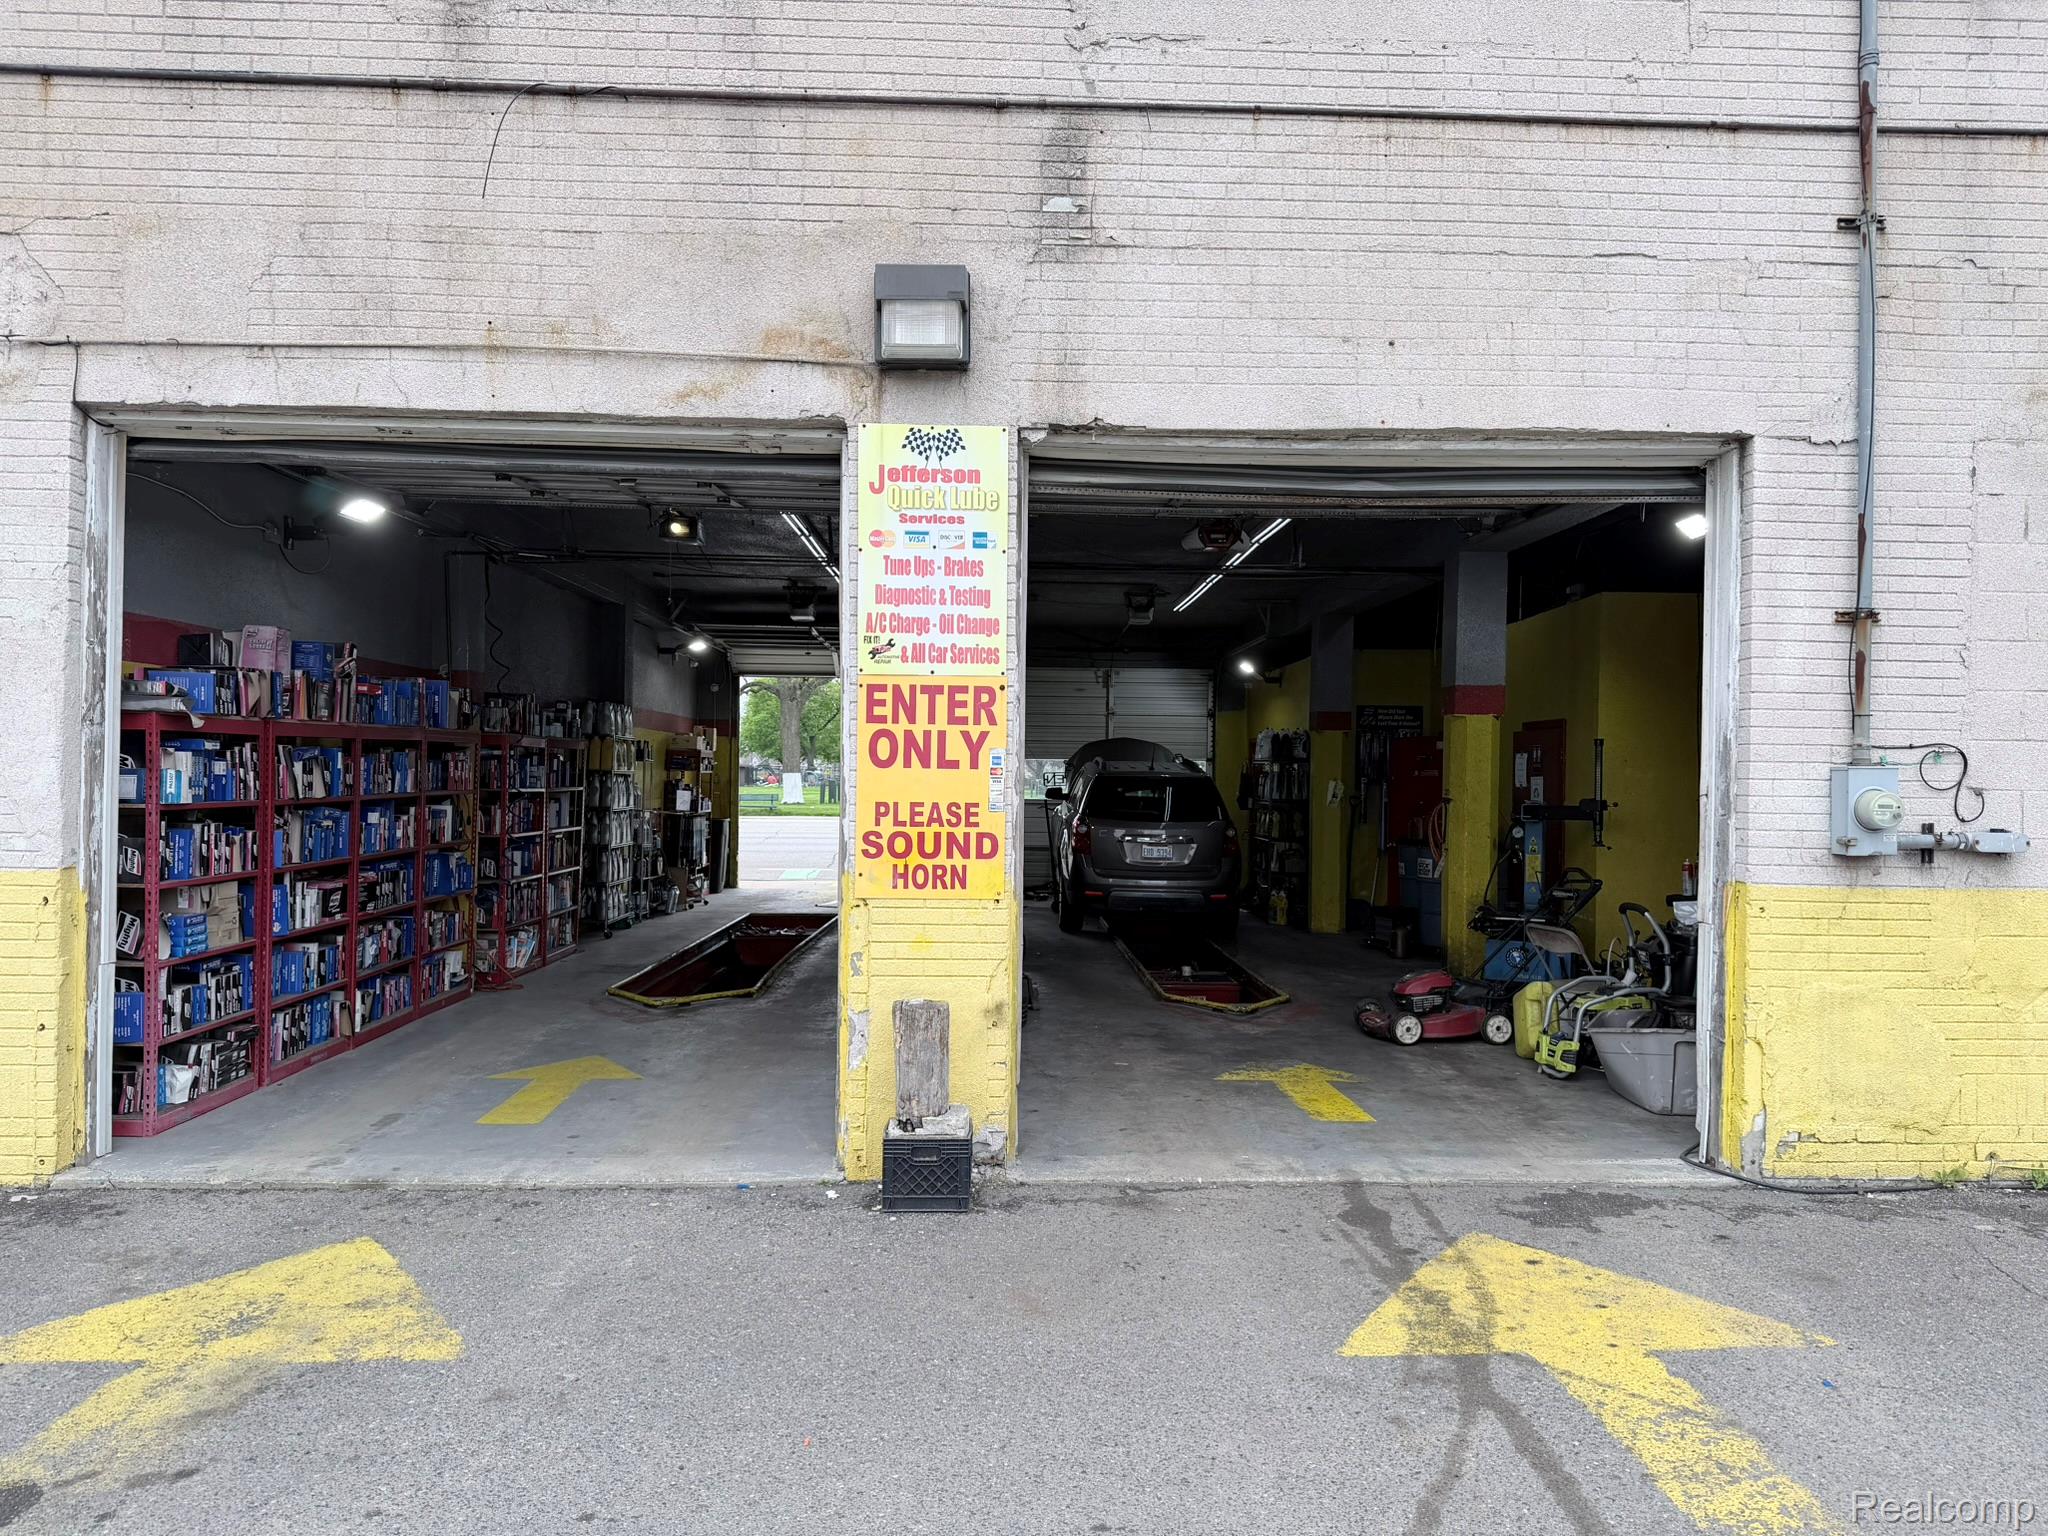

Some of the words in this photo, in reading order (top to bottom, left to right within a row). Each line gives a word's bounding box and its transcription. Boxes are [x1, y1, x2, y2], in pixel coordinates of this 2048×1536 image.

[869, 464, 980, 494] Jefferson
[888, 485, 946, 511] Quick
[950, 486, 1000, 511] Lube
[899, 513, 964, 525] Services
[883, 555, 911, 576] Tune
[914, 556, 935, 578] Ups
[944, 556, 983, 577] Brakes
[875, 584, 936, 607] Diagnostic
[939, 588, 947, 605] &
[949, 585, 991, 608] Testing
[866, 612, 886, 634] A/C
[889, 613, 930, 636] Charge
[939, 614, 954, 634] Oil
[956, 614, 1000, 637] Change
[900, 645, 909, 663] &
[911, 643, 925, 663] All
[928, 643, 948, 664] Car
[950, 643, 1000, 664] Services
[866, 684, 998, 726] ENTER
[868, 728, 990, 770] ONLY
[875, 801, 980, 827] PLEASE
[861, 830, 999, 860] SOUND
[891, 864, 967, 890] HORN
[118, 917, 137, 950] Mighty
